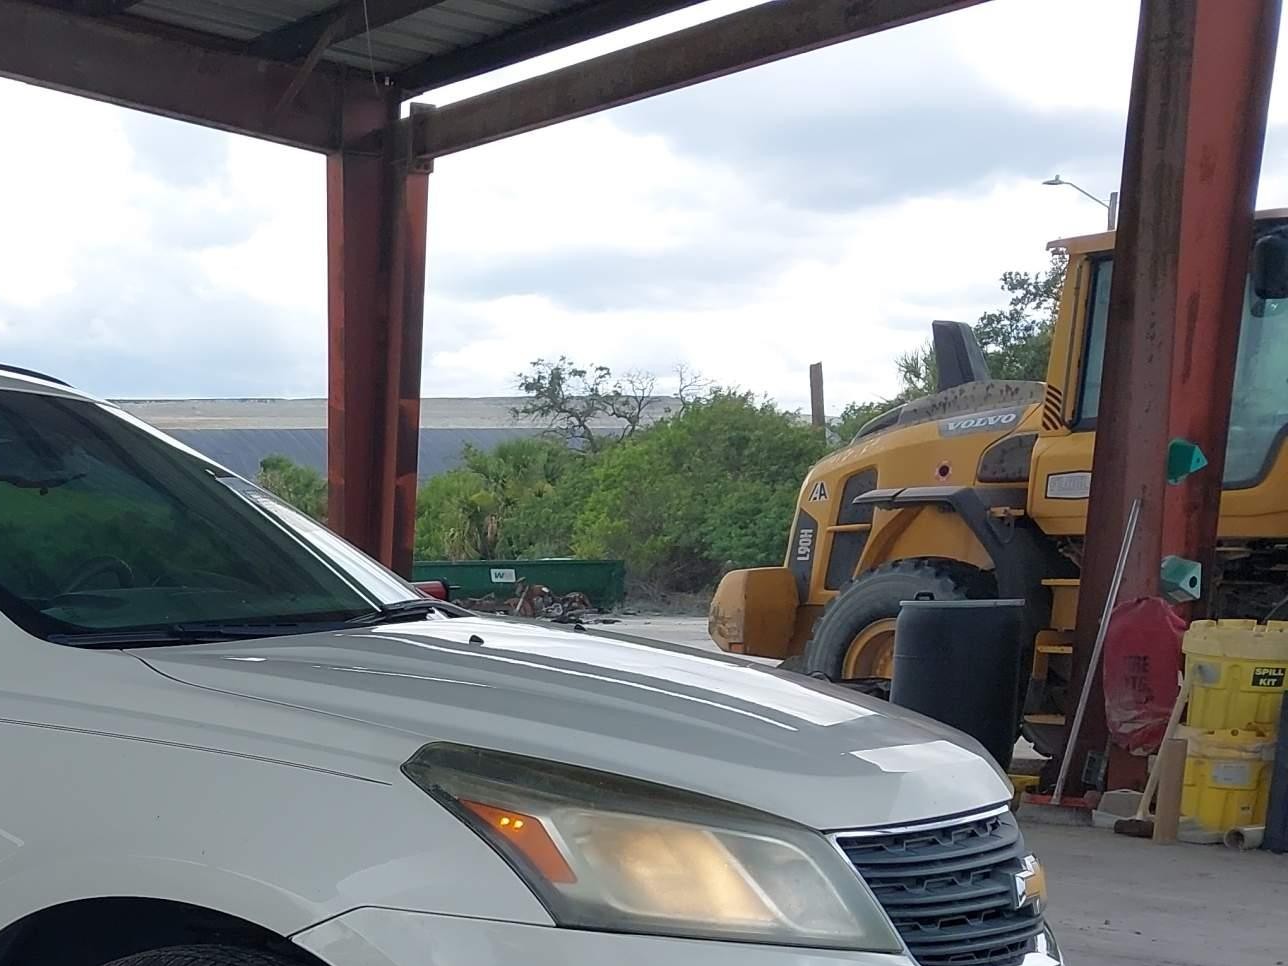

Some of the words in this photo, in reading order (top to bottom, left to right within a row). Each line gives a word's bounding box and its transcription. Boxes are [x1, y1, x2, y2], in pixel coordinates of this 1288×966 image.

[947, 413, 1016, 431] VOLVO
[796, 529, 814, 561] L90H
[1255, 668, 1284, 676] SPILL
[1259, 678, 1277, 686] KIT
